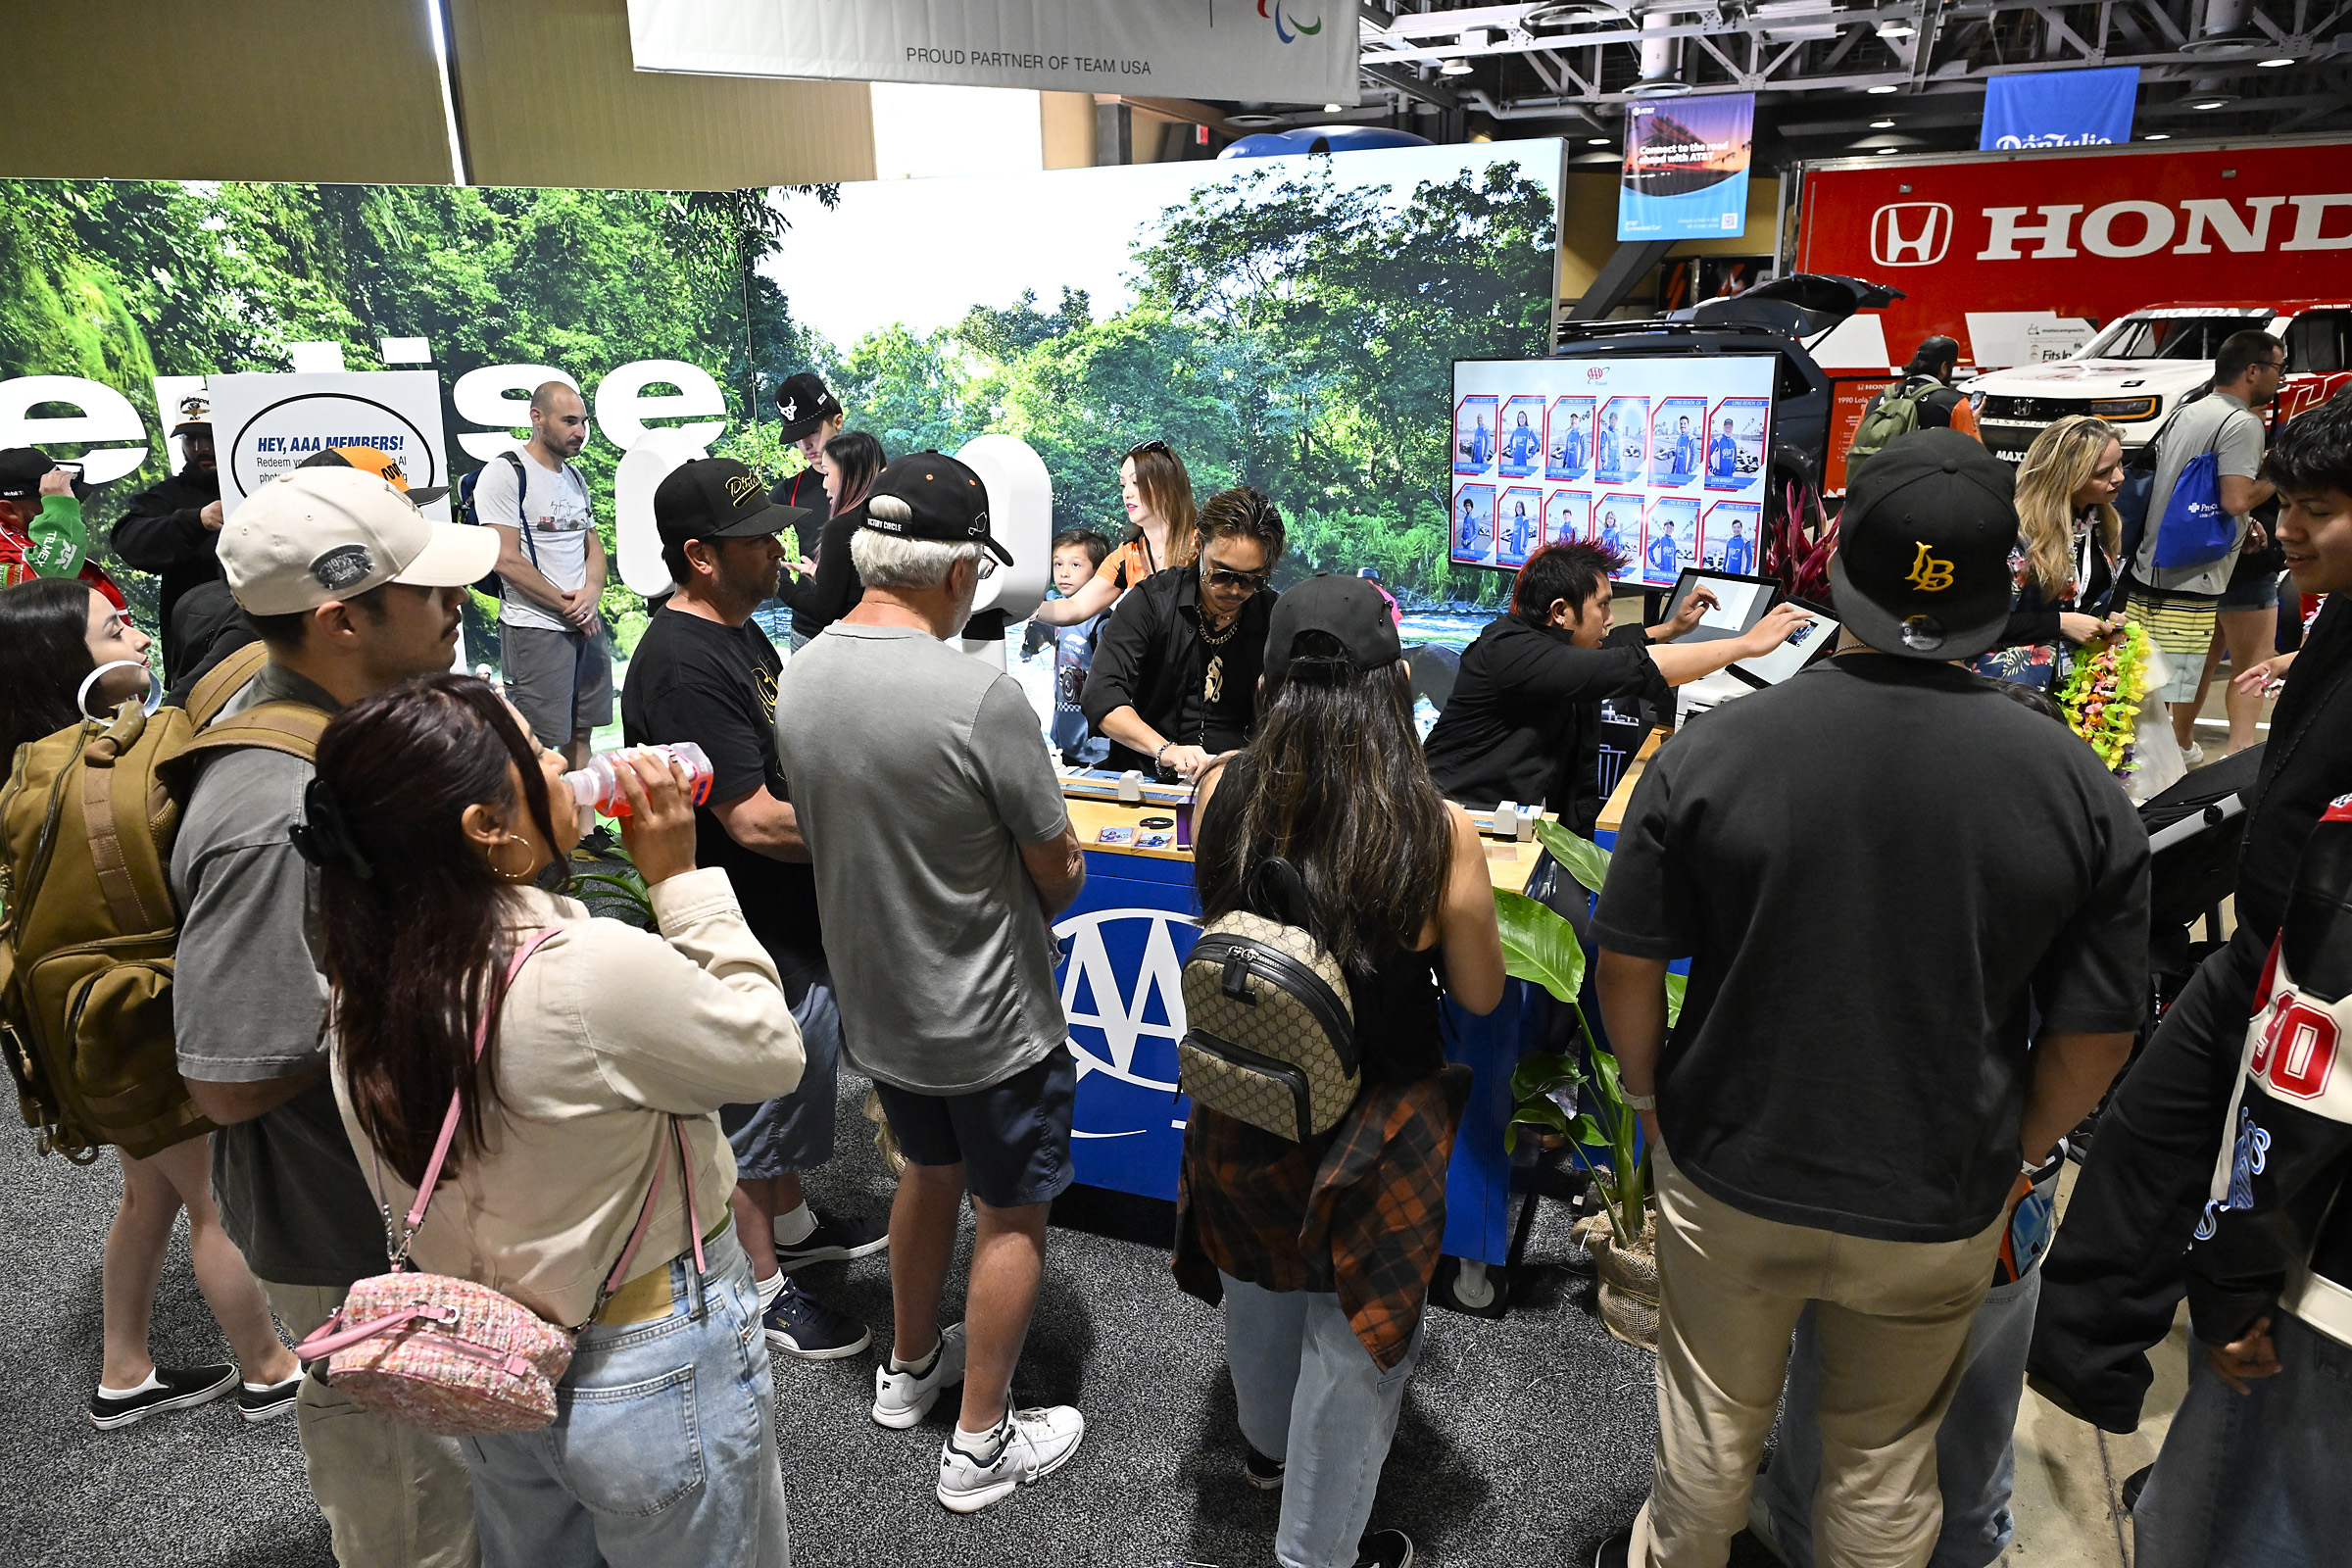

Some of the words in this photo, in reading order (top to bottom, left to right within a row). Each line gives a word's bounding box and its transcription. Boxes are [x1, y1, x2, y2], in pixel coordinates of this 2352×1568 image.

[906, 47, 965, 65] PROUD
[971, 51, 1044, 69] PARTNER
[1049, 56, 1069, 70] OF
[1074, 57, 1116, 74] TEAM
[1121, 61, 1152, 75] USA
[1639, 144, 1678, 155] Connect
[1678, 144, 1690, 153] to
[1690, 142, 1706, 153] the
[1706, 140, 1729, 151] road
[1638, 154, 1667, 165] ahead
[1667, 153, 1690, 163] with
[1690, 152, 1715, 162] AT&T
[2147, 308, 2242, 318] HONDA
[2041, 349, 2061, 361] Fits
[1588, 367, 1603, 379] AAA
[257, 437, 287, 455] HEY,
[289, 436, 321, 452] AAA
[325, 435, 405, 452] MEMBERS!
[256, 457, 291, 467] Redeem
[866, 517, 883, 529] VICTORY
[883, 520, 903, 532] CIRCLE
[33, 530, 58, 568] TELMEX
[1904, 540, 1955, 592] LB
